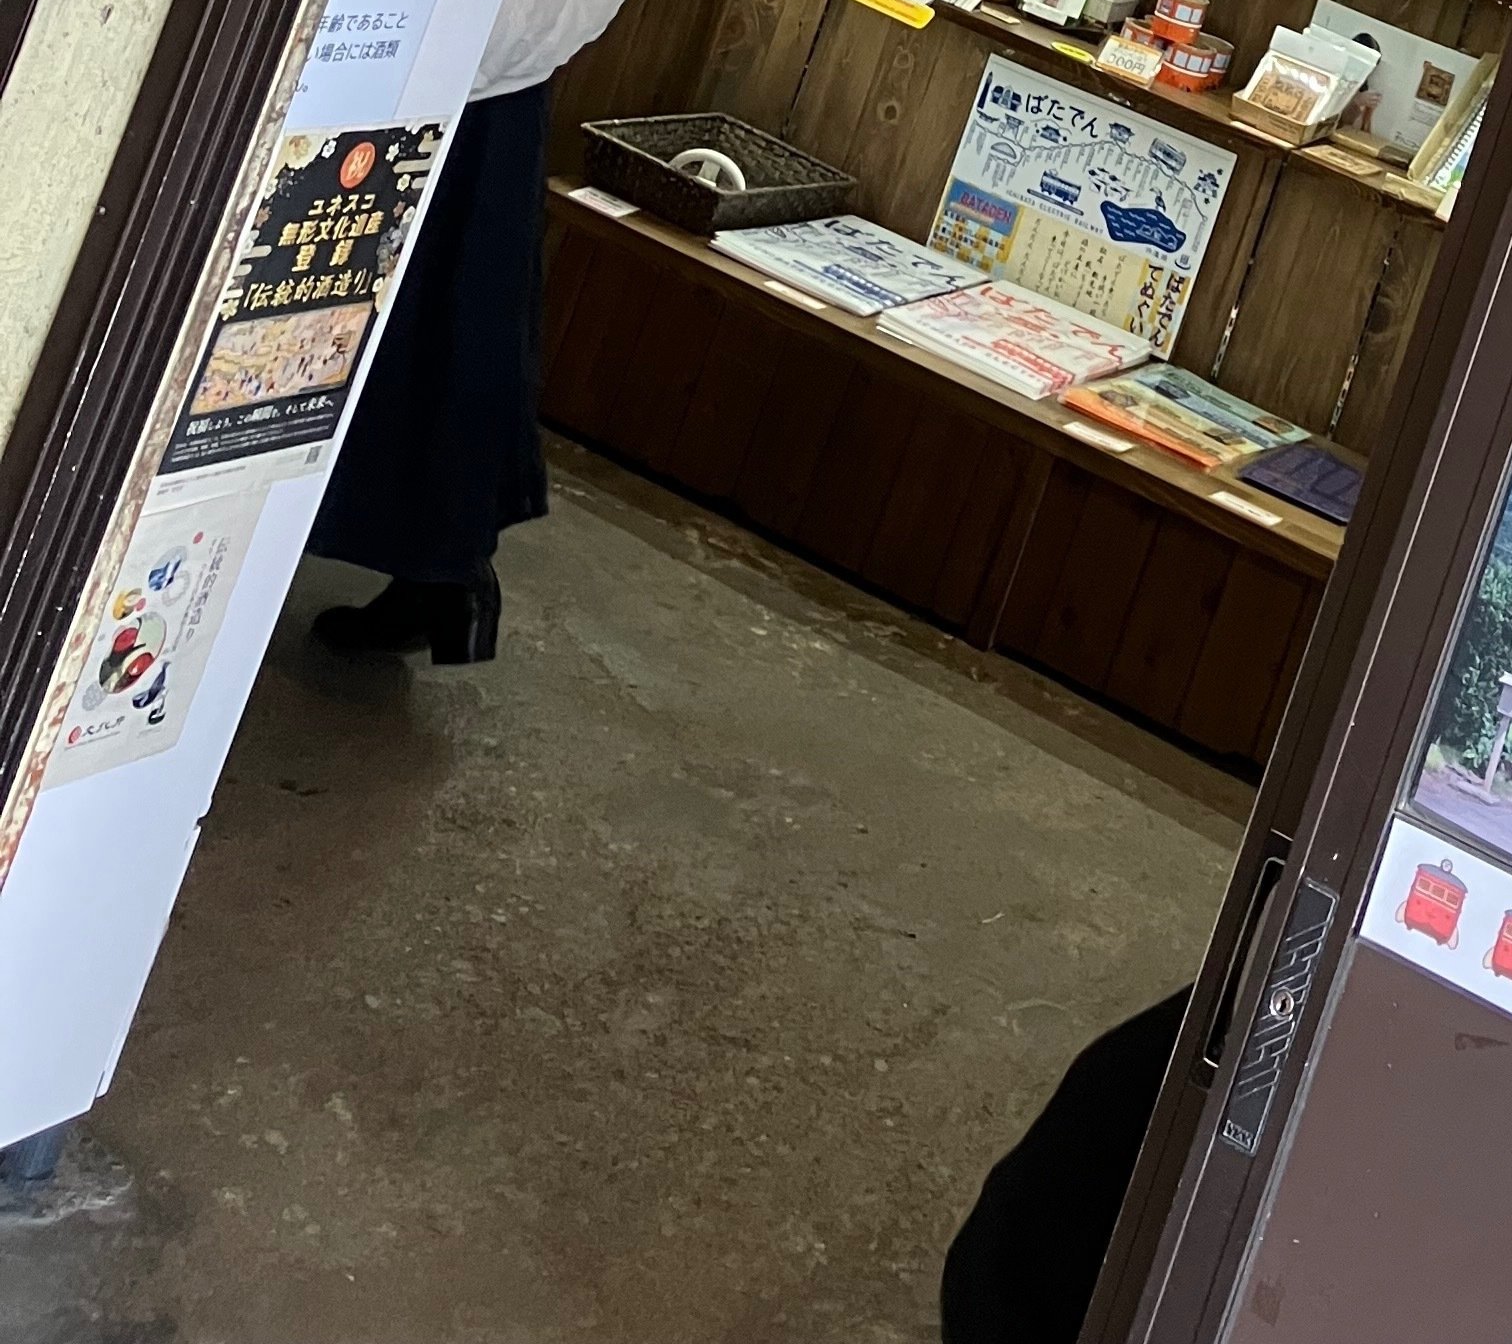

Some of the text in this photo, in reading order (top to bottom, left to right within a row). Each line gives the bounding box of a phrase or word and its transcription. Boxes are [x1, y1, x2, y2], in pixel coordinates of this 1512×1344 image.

[1024, 92, 1102, 139] ばたでん
[345, 148, 369, 183] 祝
[307, 192, 377, 217] ユネスコ
[278, 210, 386, 247] 無形文化遺産
[291, 241, 356, 272] 登録
[824, 218, 959, 289] ばたでん
[242, 267, 374, 312] 「伝統的酒造り」
[1129, 264, 1166, 335] てぬぐい
[1147, 274, 1187, 348] ばたでん
[978, 284, 1124, 367] ばたでん
